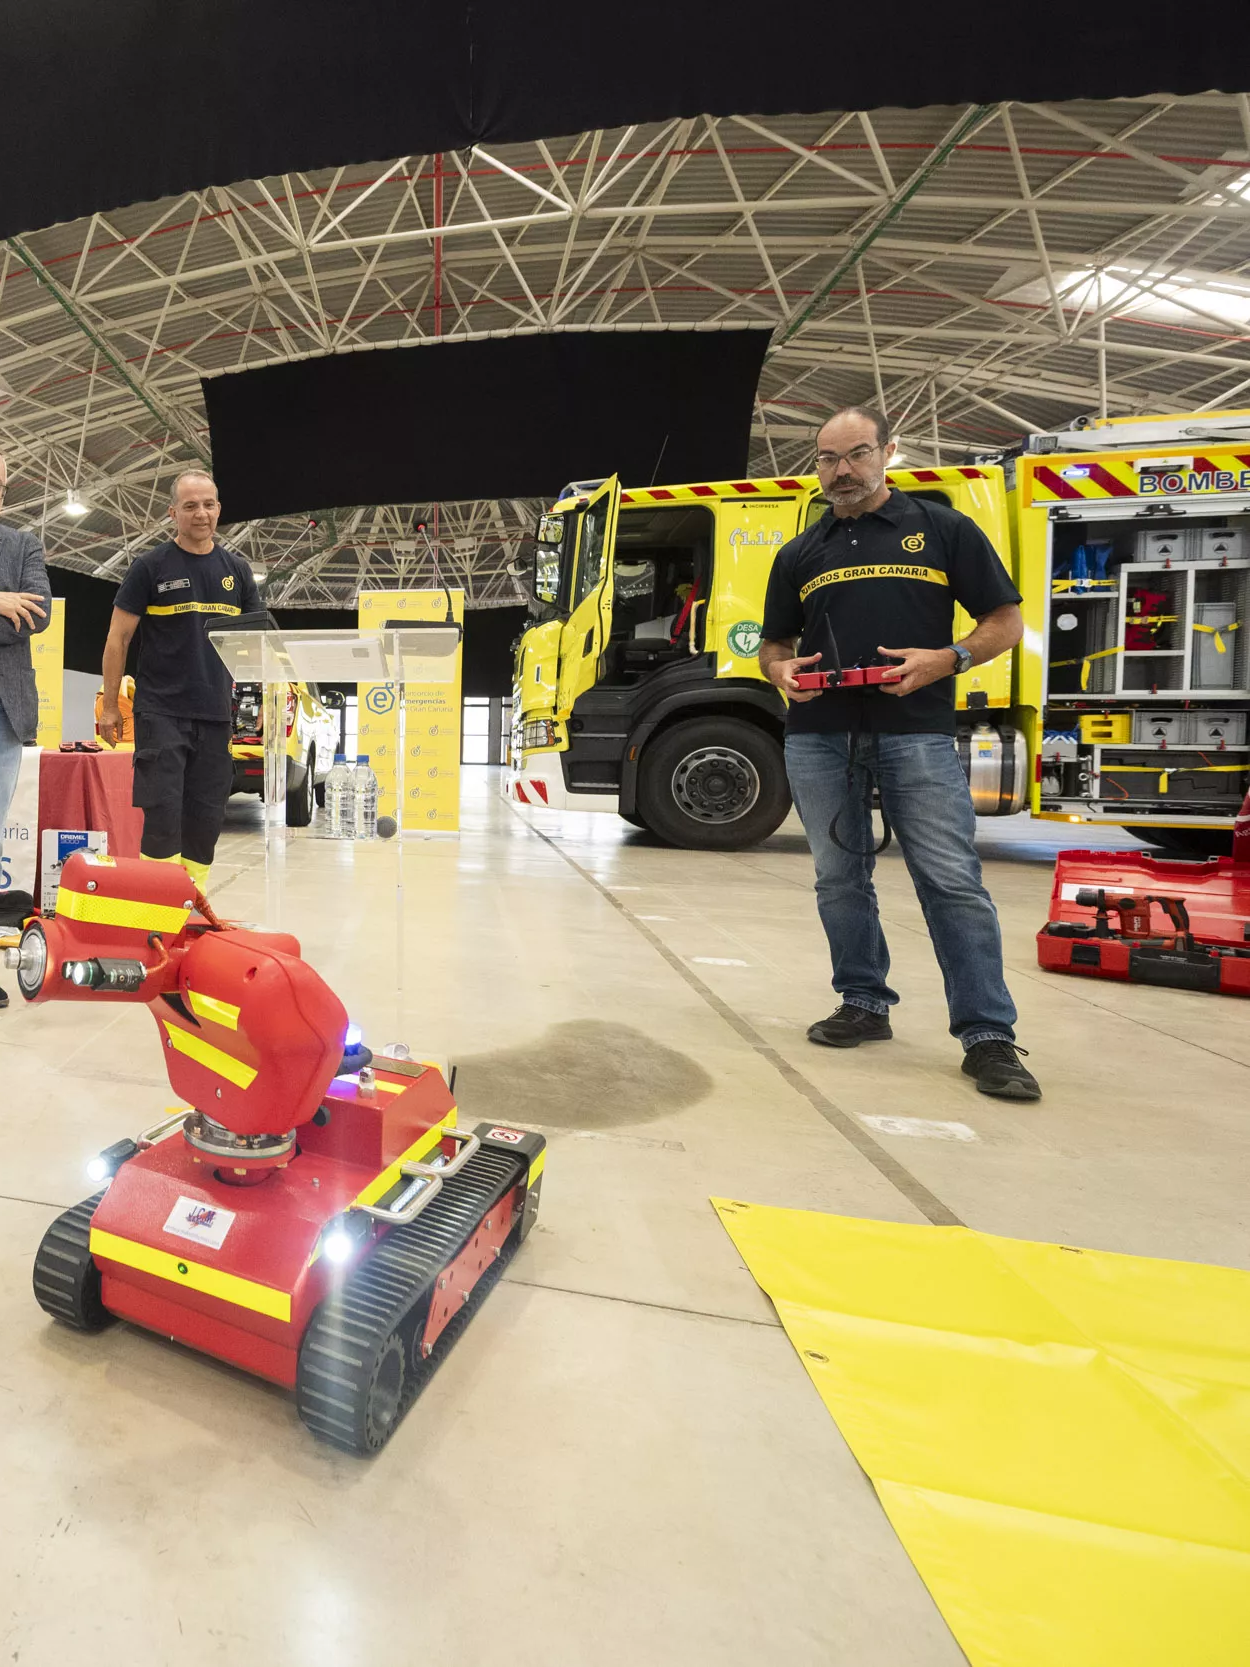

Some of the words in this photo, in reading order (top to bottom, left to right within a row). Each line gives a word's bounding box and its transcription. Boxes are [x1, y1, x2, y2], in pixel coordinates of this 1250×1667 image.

[843, 567, 875, 579] GRAN
[878, 566, 928, 578] CANARIA
[737, 623, 759, 632] DESA
[405, 698, 446, 707] mergencias
